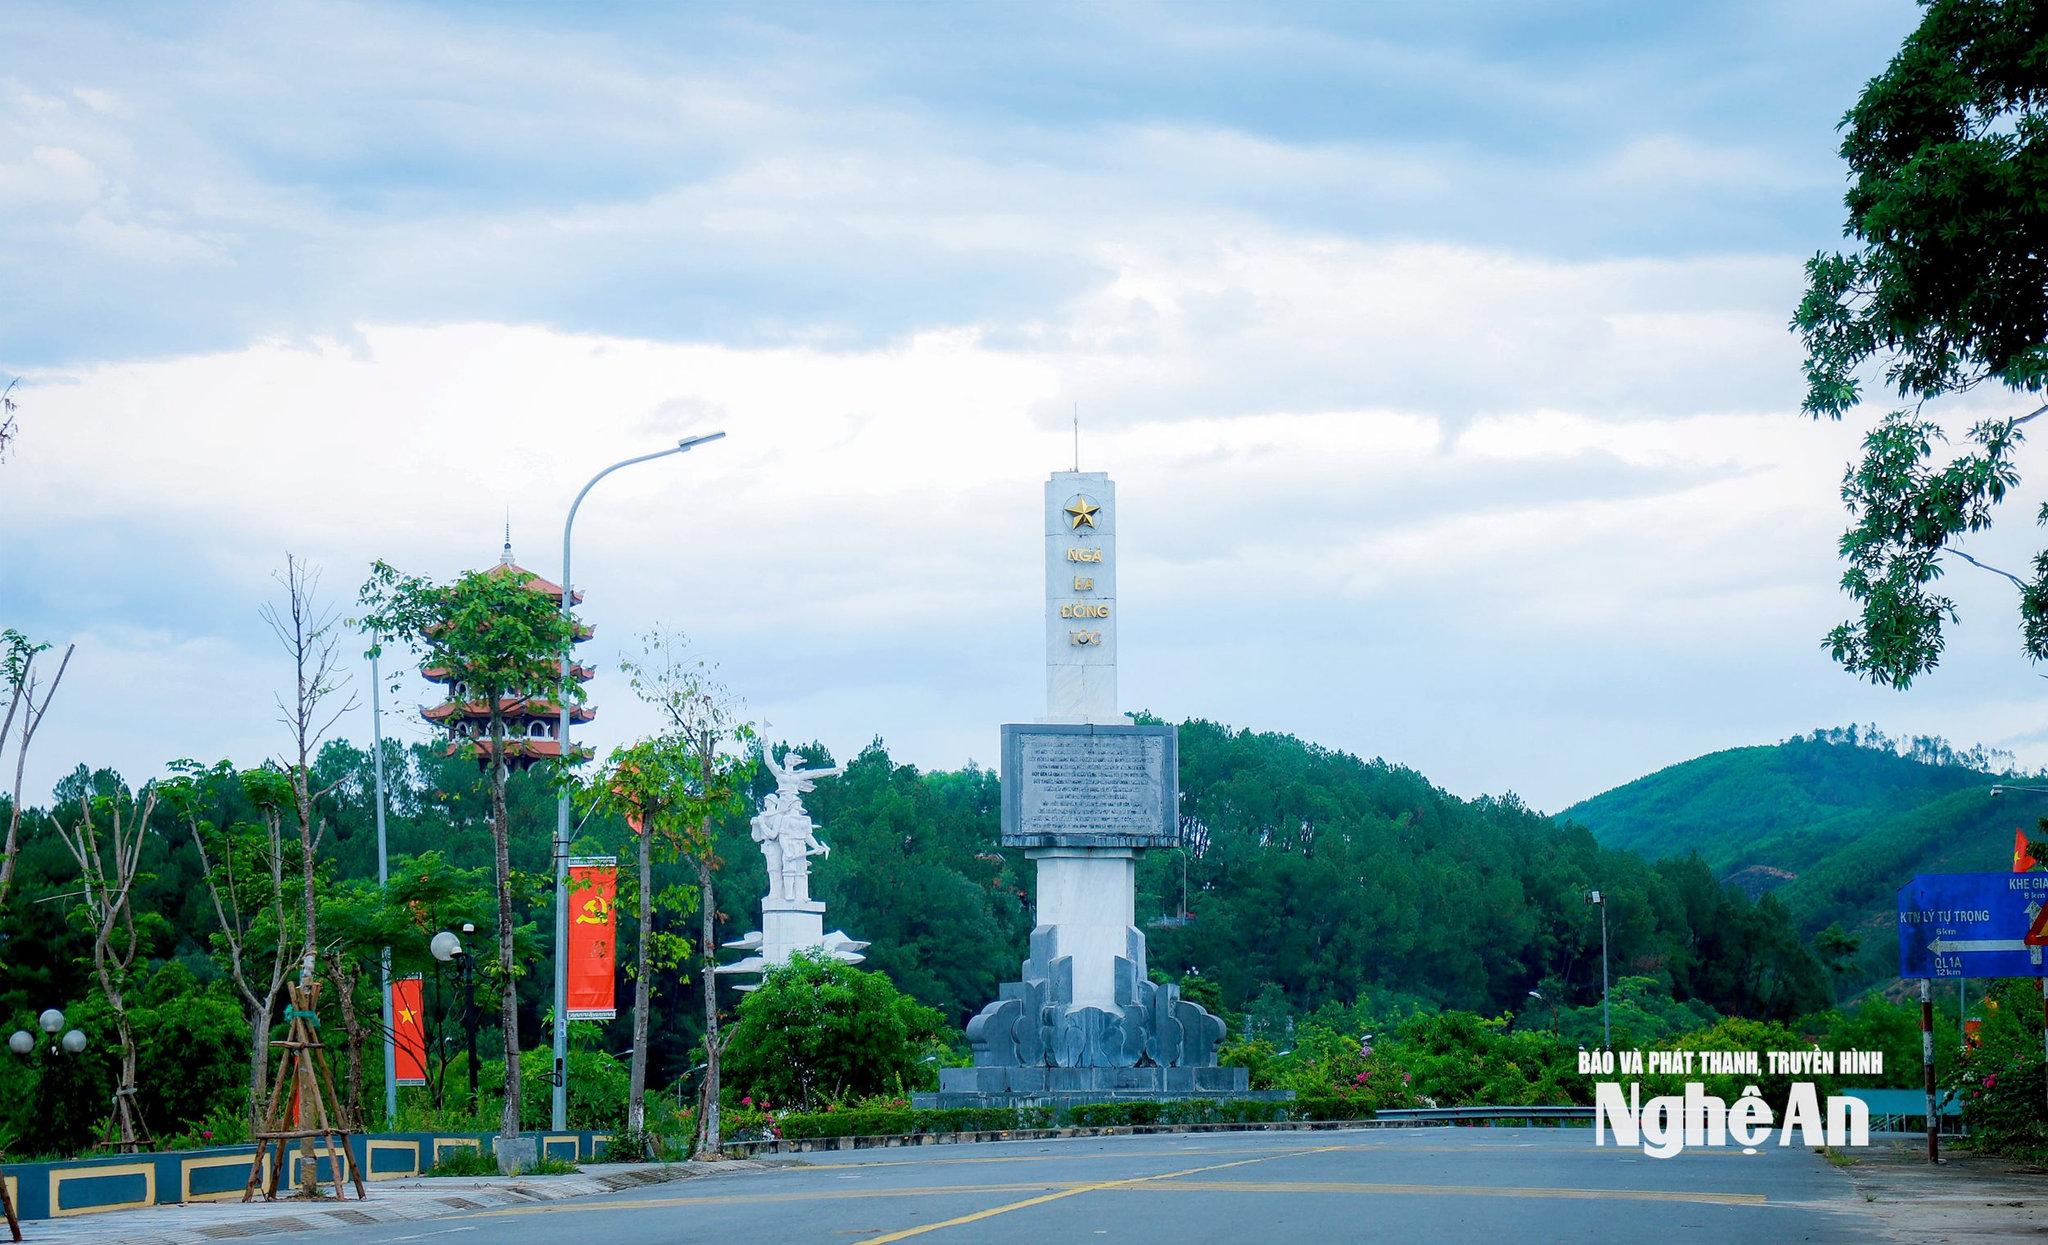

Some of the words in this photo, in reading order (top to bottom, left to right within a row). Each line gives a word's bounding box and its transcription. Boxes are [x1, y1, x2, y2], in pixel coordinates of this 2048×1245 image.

[2009, 878, 2029, 890] KHE
[1923, 909, 1935, 922] LÝ
[1937, 909, 1951, 924] TỰ
[1954, 910, 1990, 924] TRỌNG
